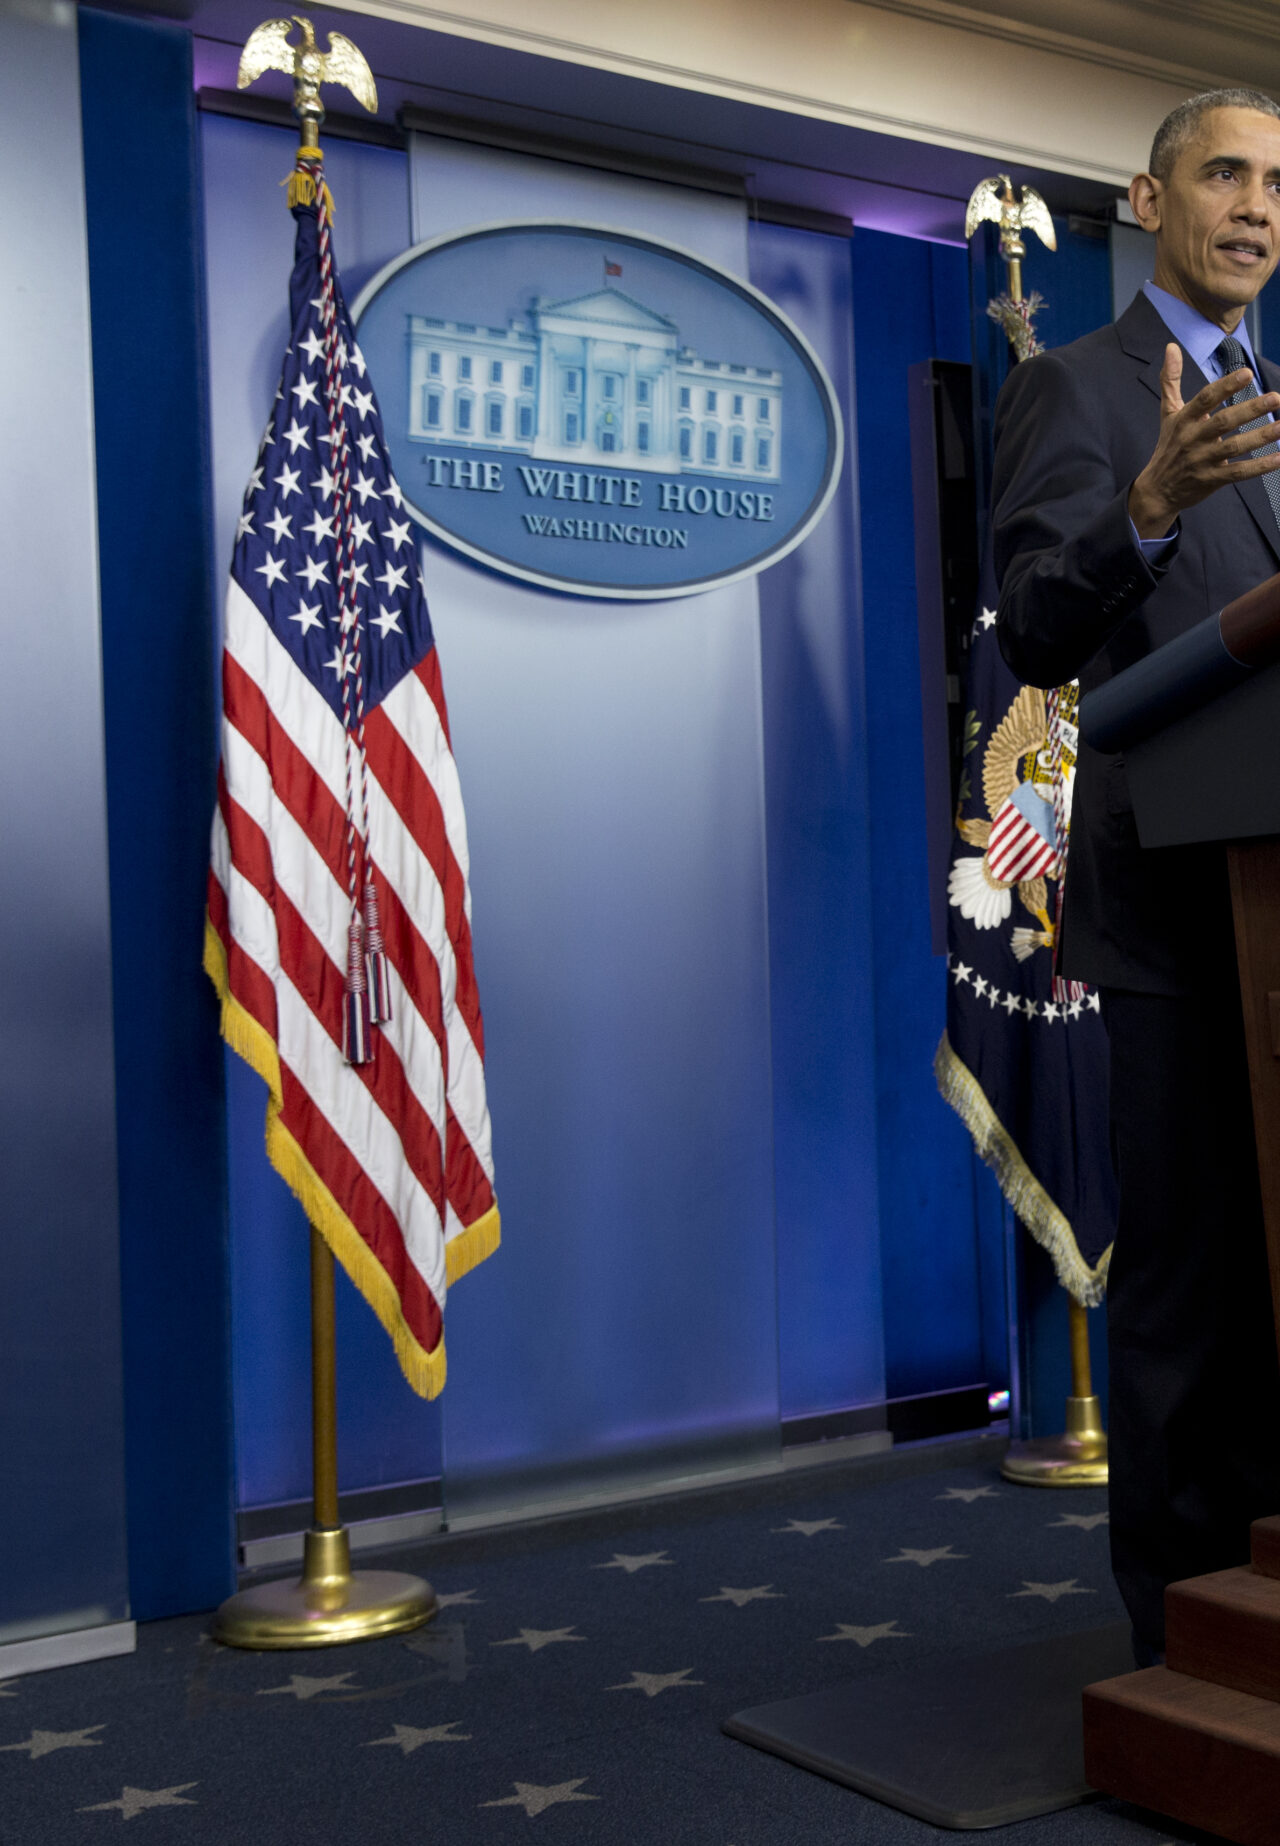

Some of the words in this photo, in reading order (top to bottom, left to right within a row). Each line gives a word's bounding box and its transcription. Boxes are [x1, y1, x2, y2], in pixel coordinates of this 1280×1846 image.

[427, 456, 504, 491] THE
[519, 466, 643, 507] WHITE
[660, 483, 775, 521] HOUSE
[523, 514, 688, 548] WASHINGTON
